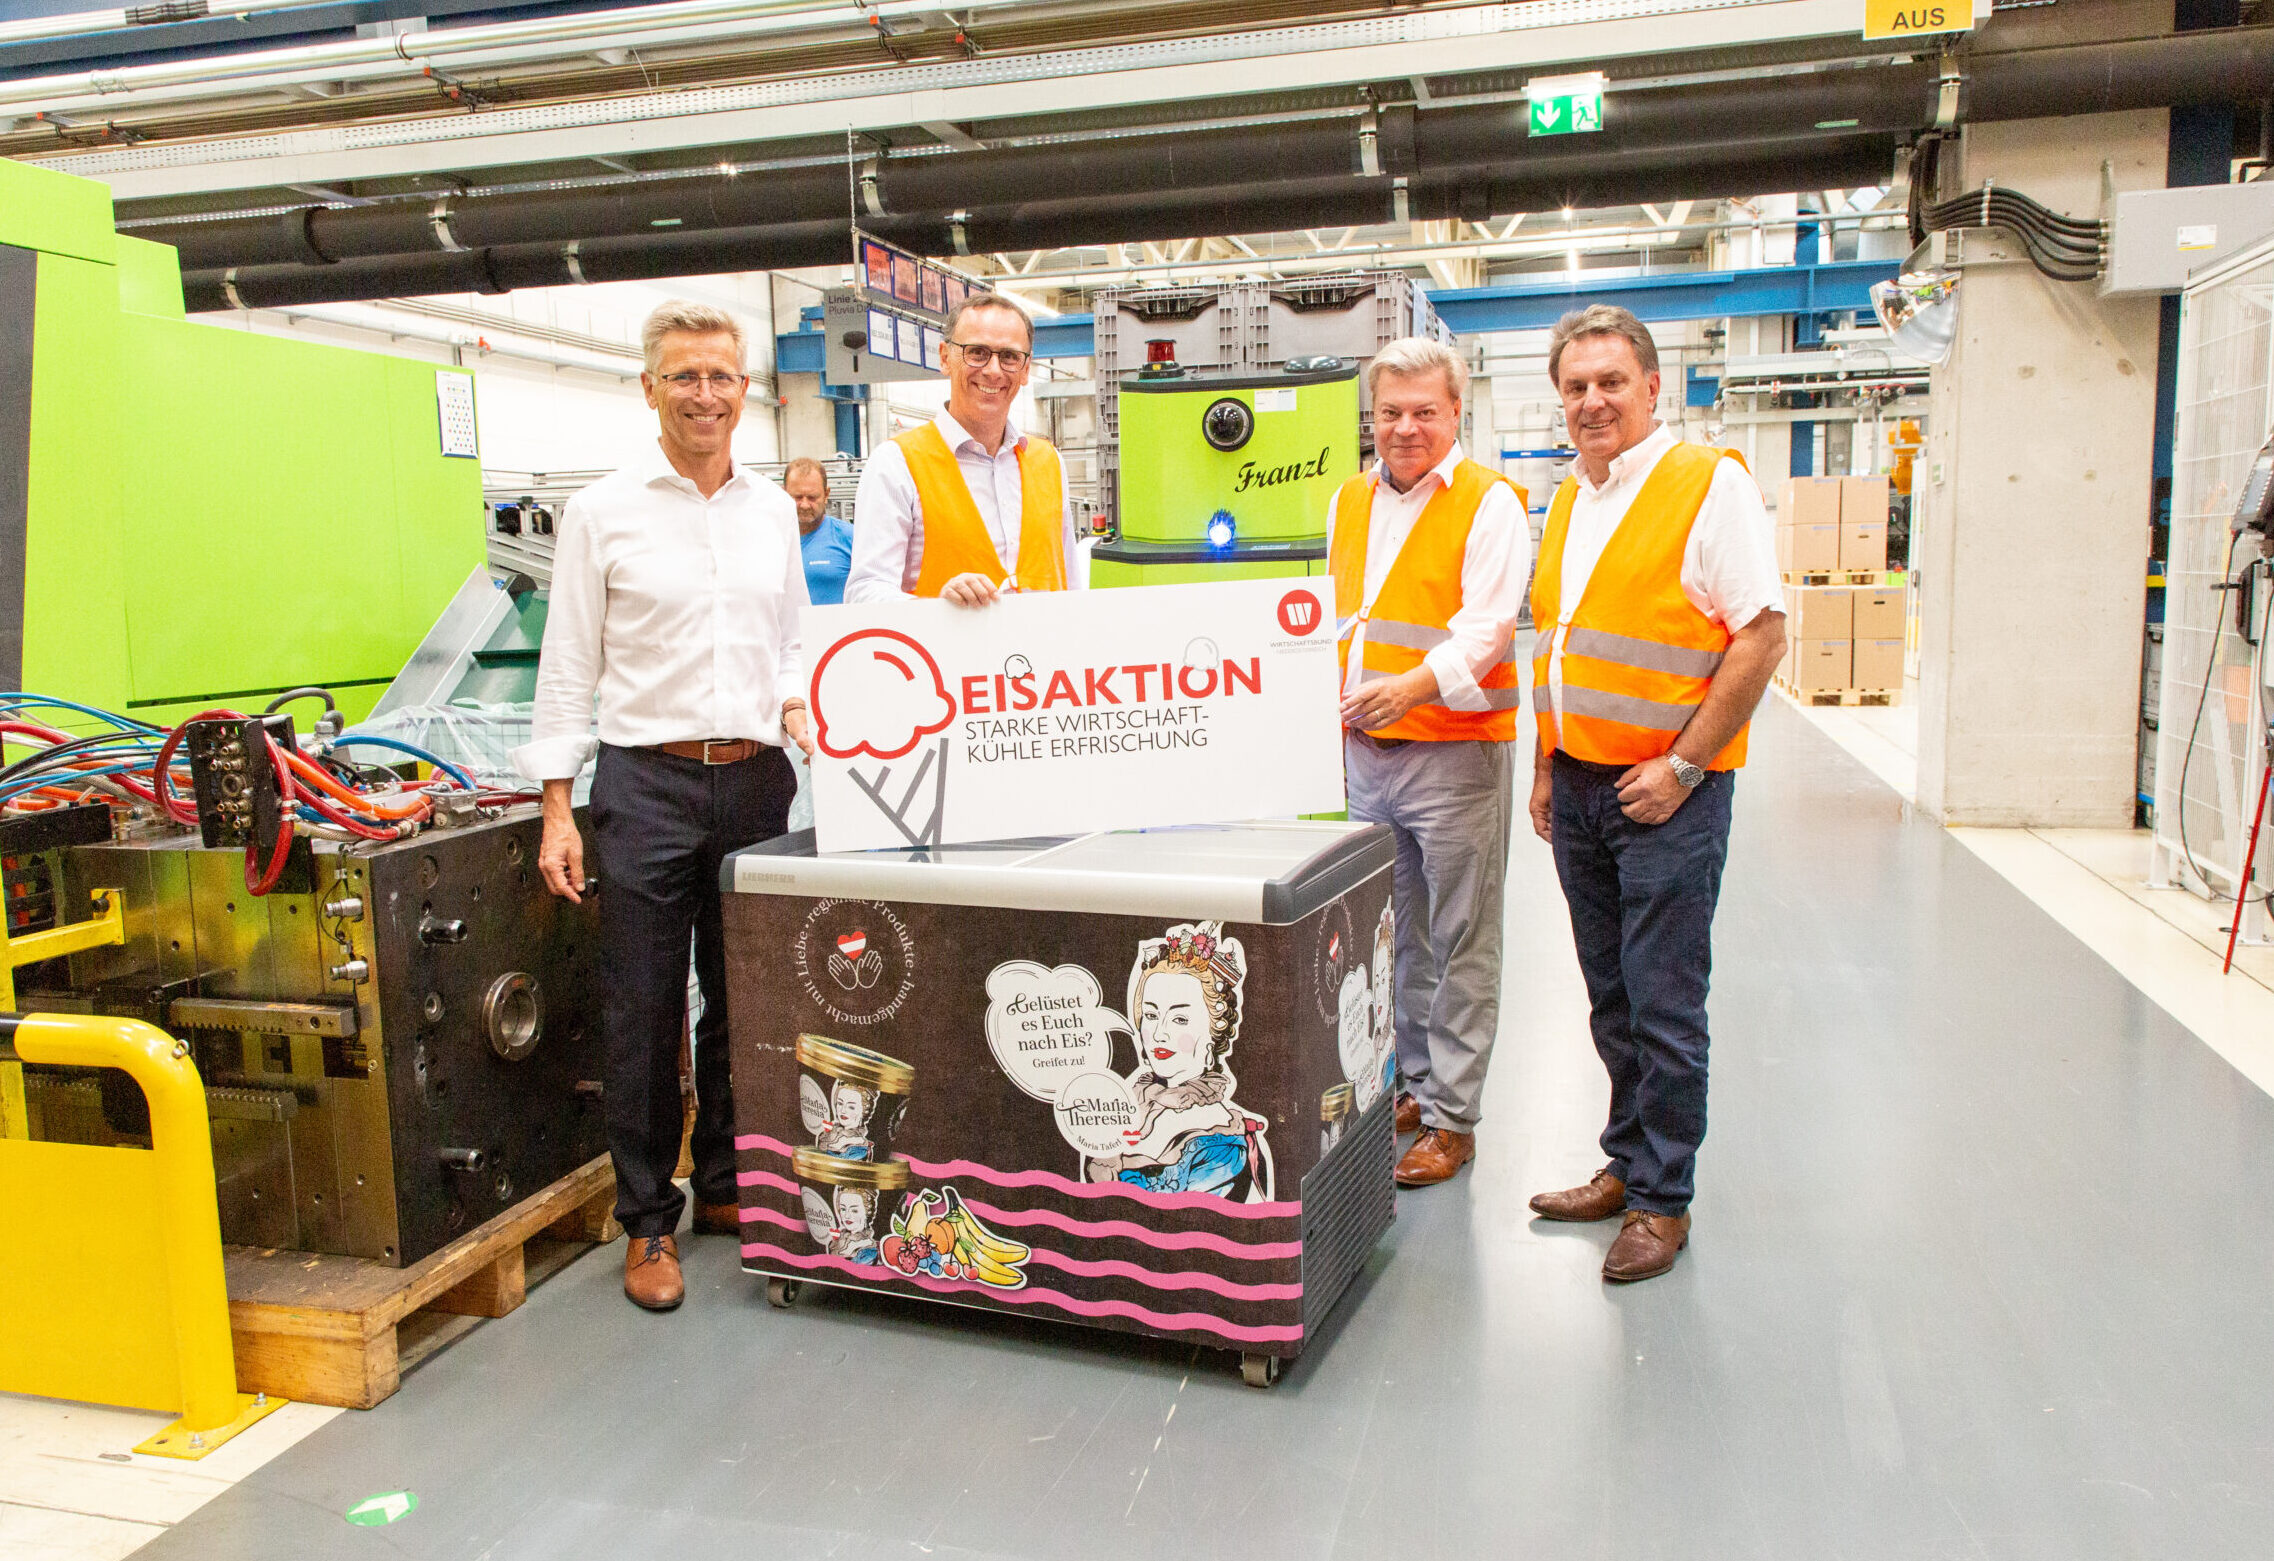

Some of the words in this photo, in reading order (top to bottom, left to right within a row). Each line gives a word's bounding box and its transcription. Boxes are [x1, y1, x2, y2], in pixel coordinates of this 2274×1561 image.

[1892, 8, 1945, 31] AUS
[828, 295, 851, 304] Linie
[828, 305, 855, 315] Pluvia
[1234, 446, 1330, 493] Franzl
[961, 657, 1262, 714] EISAKTION
[965, 717, 1049, 740] STARKE
[1056, 706, 1209, 732] WIRTSCHAFT-
[968, 740, 1043, 763] KÜHLE
[1051, 728, 1208, 758] ERFRISCHUNG
[873, 900, 915, 969] Produkte
[795, 930, 809, 978] Liebe
[803, 979, 826, 1007] mit
[825, 979, 915, 1026] handgemacht
[1006, 992, 1083, 1016] Gelüstet
[1021, 1018, 1038, 1032] es
[1042, 1013, 1084, 1031] Euch
[1018, 1033, 1057, 1052] nach
[1062, 1031, 1093, 1049] Eis?
[1032, 1056, 1068, 1069] Greifet
[1070, 1055, 1085, 1067] zu!
[1064, 1107, 1132, 1127] Theresia
[1076, 1098, 1136, 1114] Maria
[1076, 1135, 1099, 1151] Maria
[1100, 1138, 1122, 1152] Taferl
